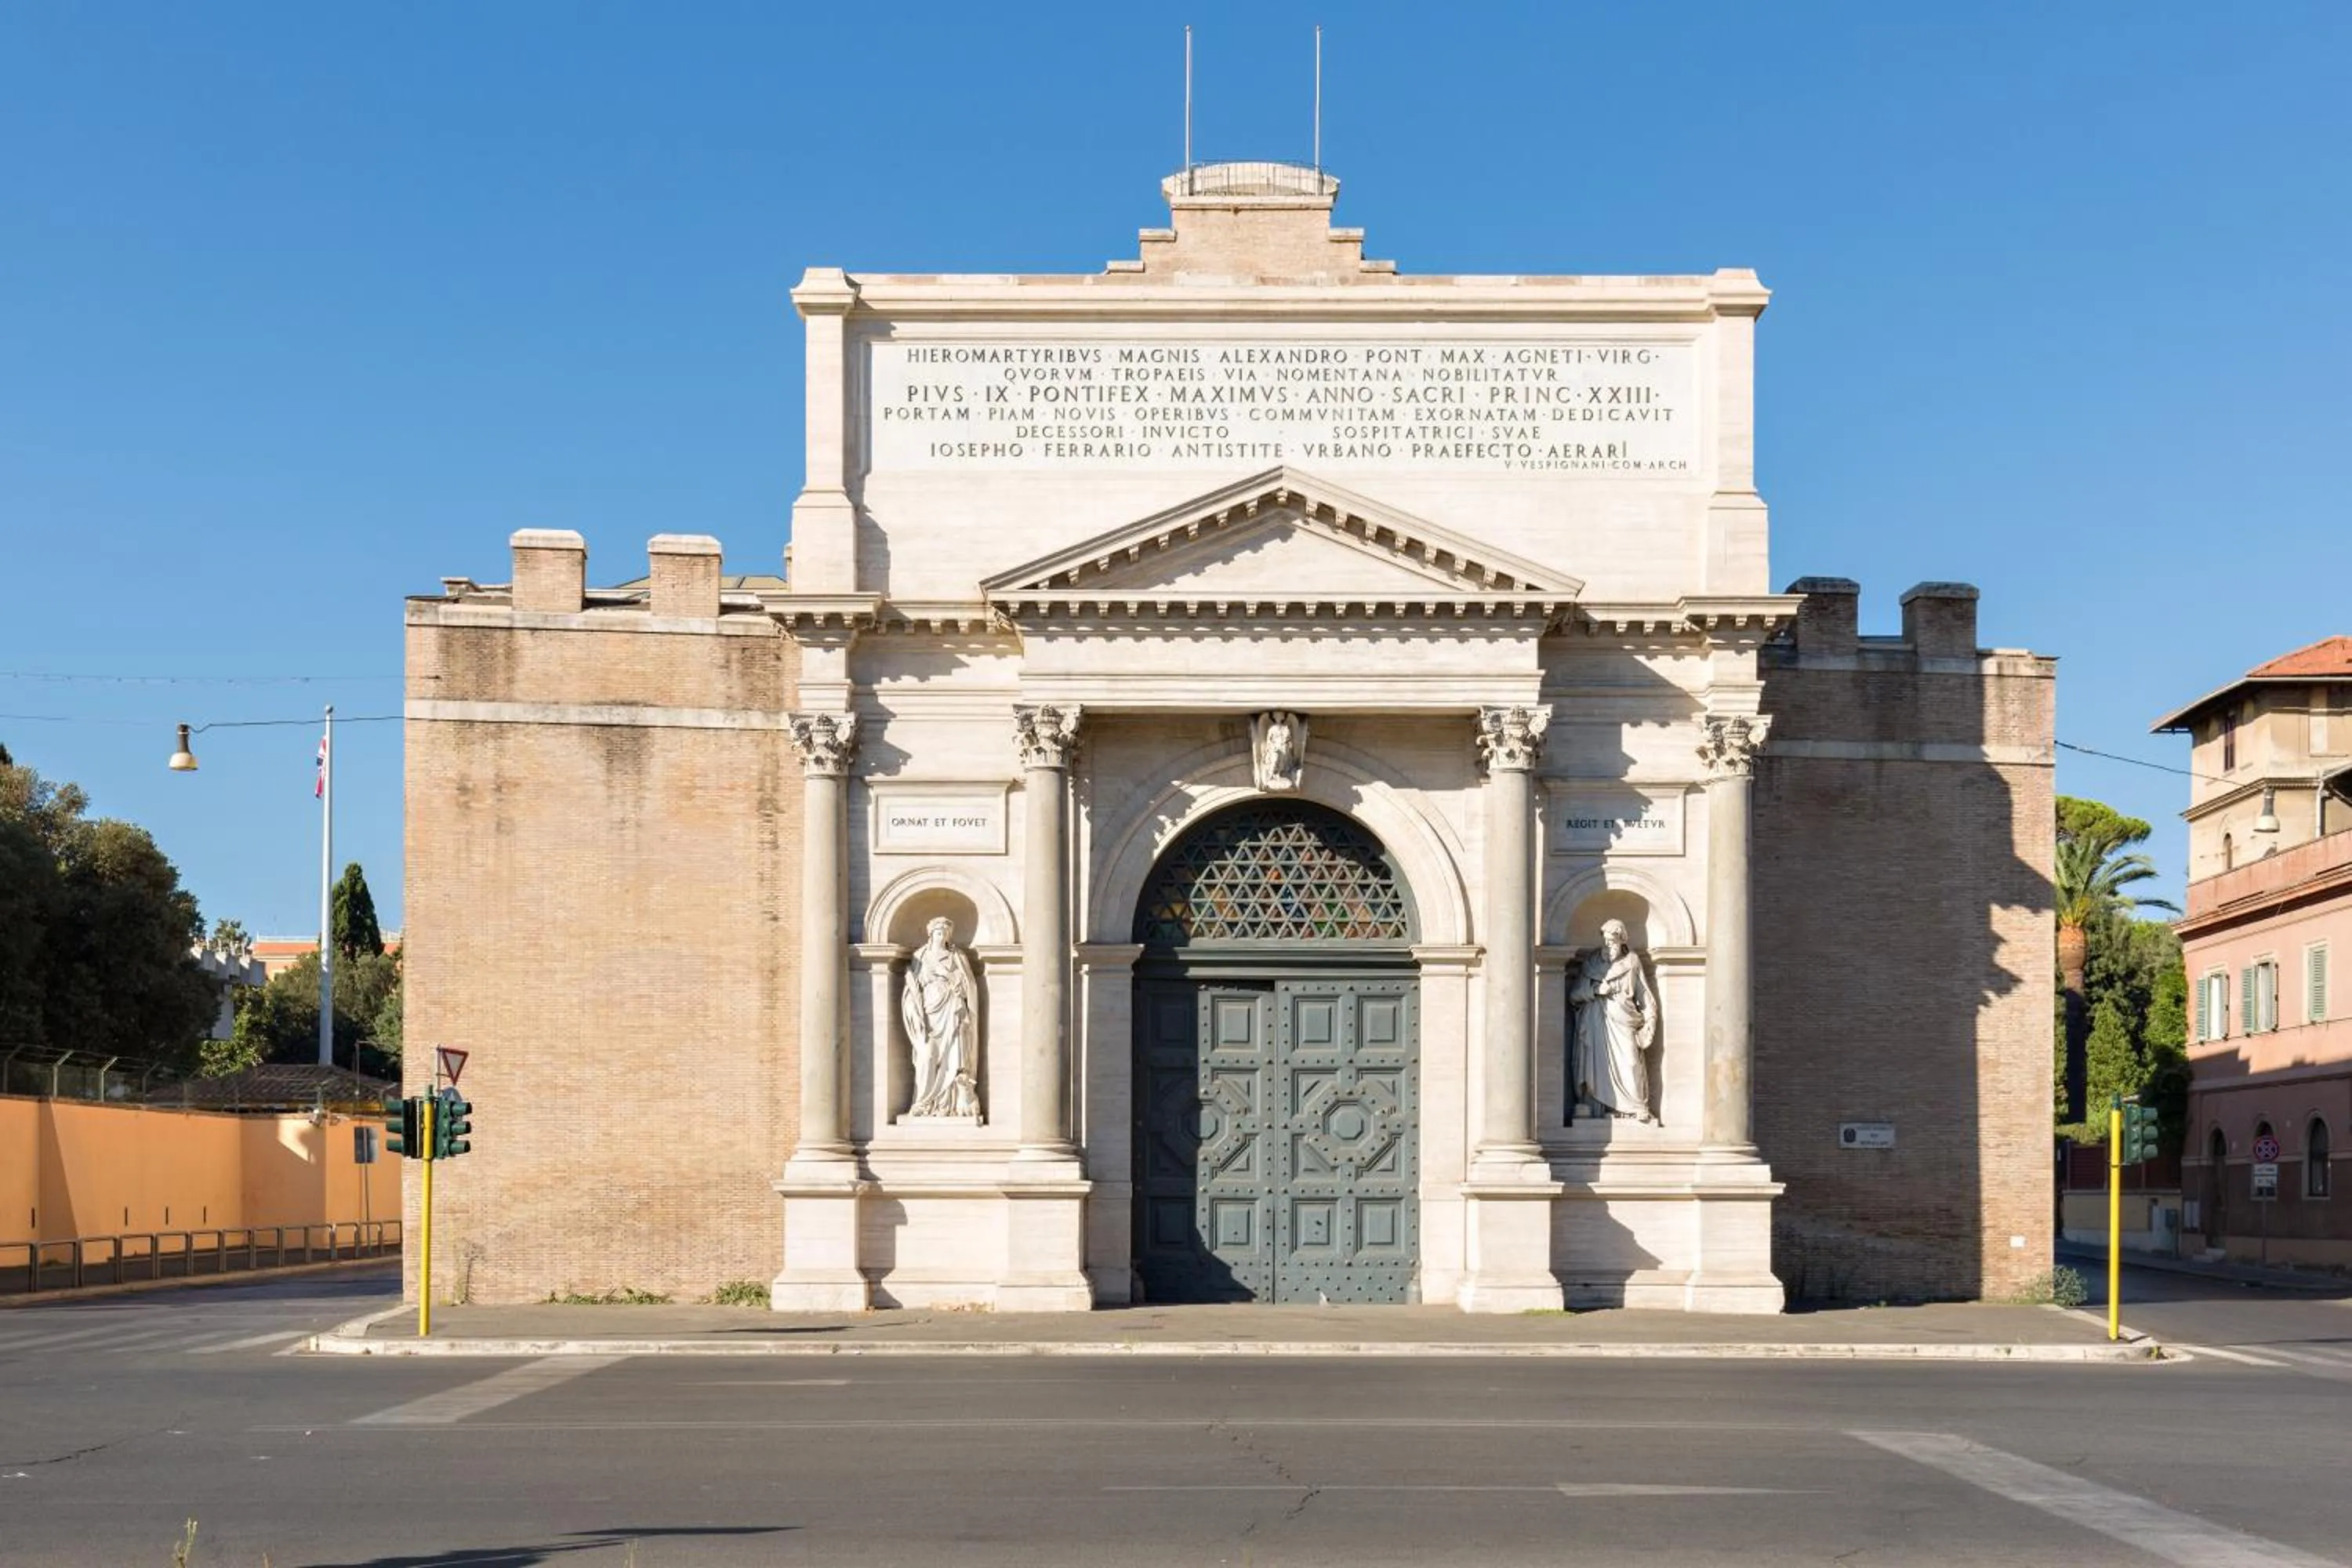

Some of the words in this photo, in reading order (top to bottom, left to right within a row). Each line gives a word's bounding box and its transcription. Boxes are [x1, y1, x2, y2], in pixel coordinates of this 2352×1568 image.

[907, 348, 1102, 364] HIEROMARTYRIBVS
[1120, 349, 1200, 364] MAGNIS
[1219, 349, 1348, 364] ALEXANDRO
[1367, 349, 1422, 364] PONT
[1441, 349, 1485, 364] MAX
[1503, 349, 1582, 364] AGNETI
[1004, 368, 1092, 383] QVORVM
[1111, 368, 1205, 382] TROPAEIS
[1224, 368, 1258, 382] VIA
[1277, 368, 1403, 382] NOMENTANA
[1423, 368, 1558, 382] NOBILITATVR
[907, 385, 964, 403] PIVS
[985, 385, 1010, 403] IX
[1029, 385, 1149, 403] PONTIFEX
[1171, 386, 1287, 404] MAXIMVS
[1306, 387, 1374, 404] ANNO
[1392, 387, 1465, 404] SACRI
[1490, 387, 1570, 405] PRINC
[1588, 387, 1652, 404] XXIII
[884, 407, 970, 421] PORTAM
[989, 407, 1035, 421] PIAM
[1054, 407, 1116, 422] NOVIS
[1134, 407, 1229, 422] OPERIBVS
[1249, 408, 1396, 422] COMMVNITAM
[1415, 408, 1537, 422] EXORNATAM
[1552, 408, 1674, 422] DEDICAVIT
[1016, 425, 1123, 439] DECESSORI
[1142, 426, 1229, 440] INVICTO
[1333, 426, 1473, 440] SOSPITATRICI
[1493, 426, 1541, 440] SVAE
[931, 442, 1024, 458] IOSEPHO
[1044, 443, 1152, 459] FERRARIO
[1171, 443, 1283, 459] ANTISTITE
[1303, 443, 1392, 459] VRBANO
[1412, 443, 1532, 459] PRAEFECTO
[891, 818, 928, 827] ORNAT
[935, 818, 947, 827] ET
[953, 818, 988, 827] FOVET
[1566, 819, 1598, 829] REGIT
[1603, 819, 1615, 829] ET
